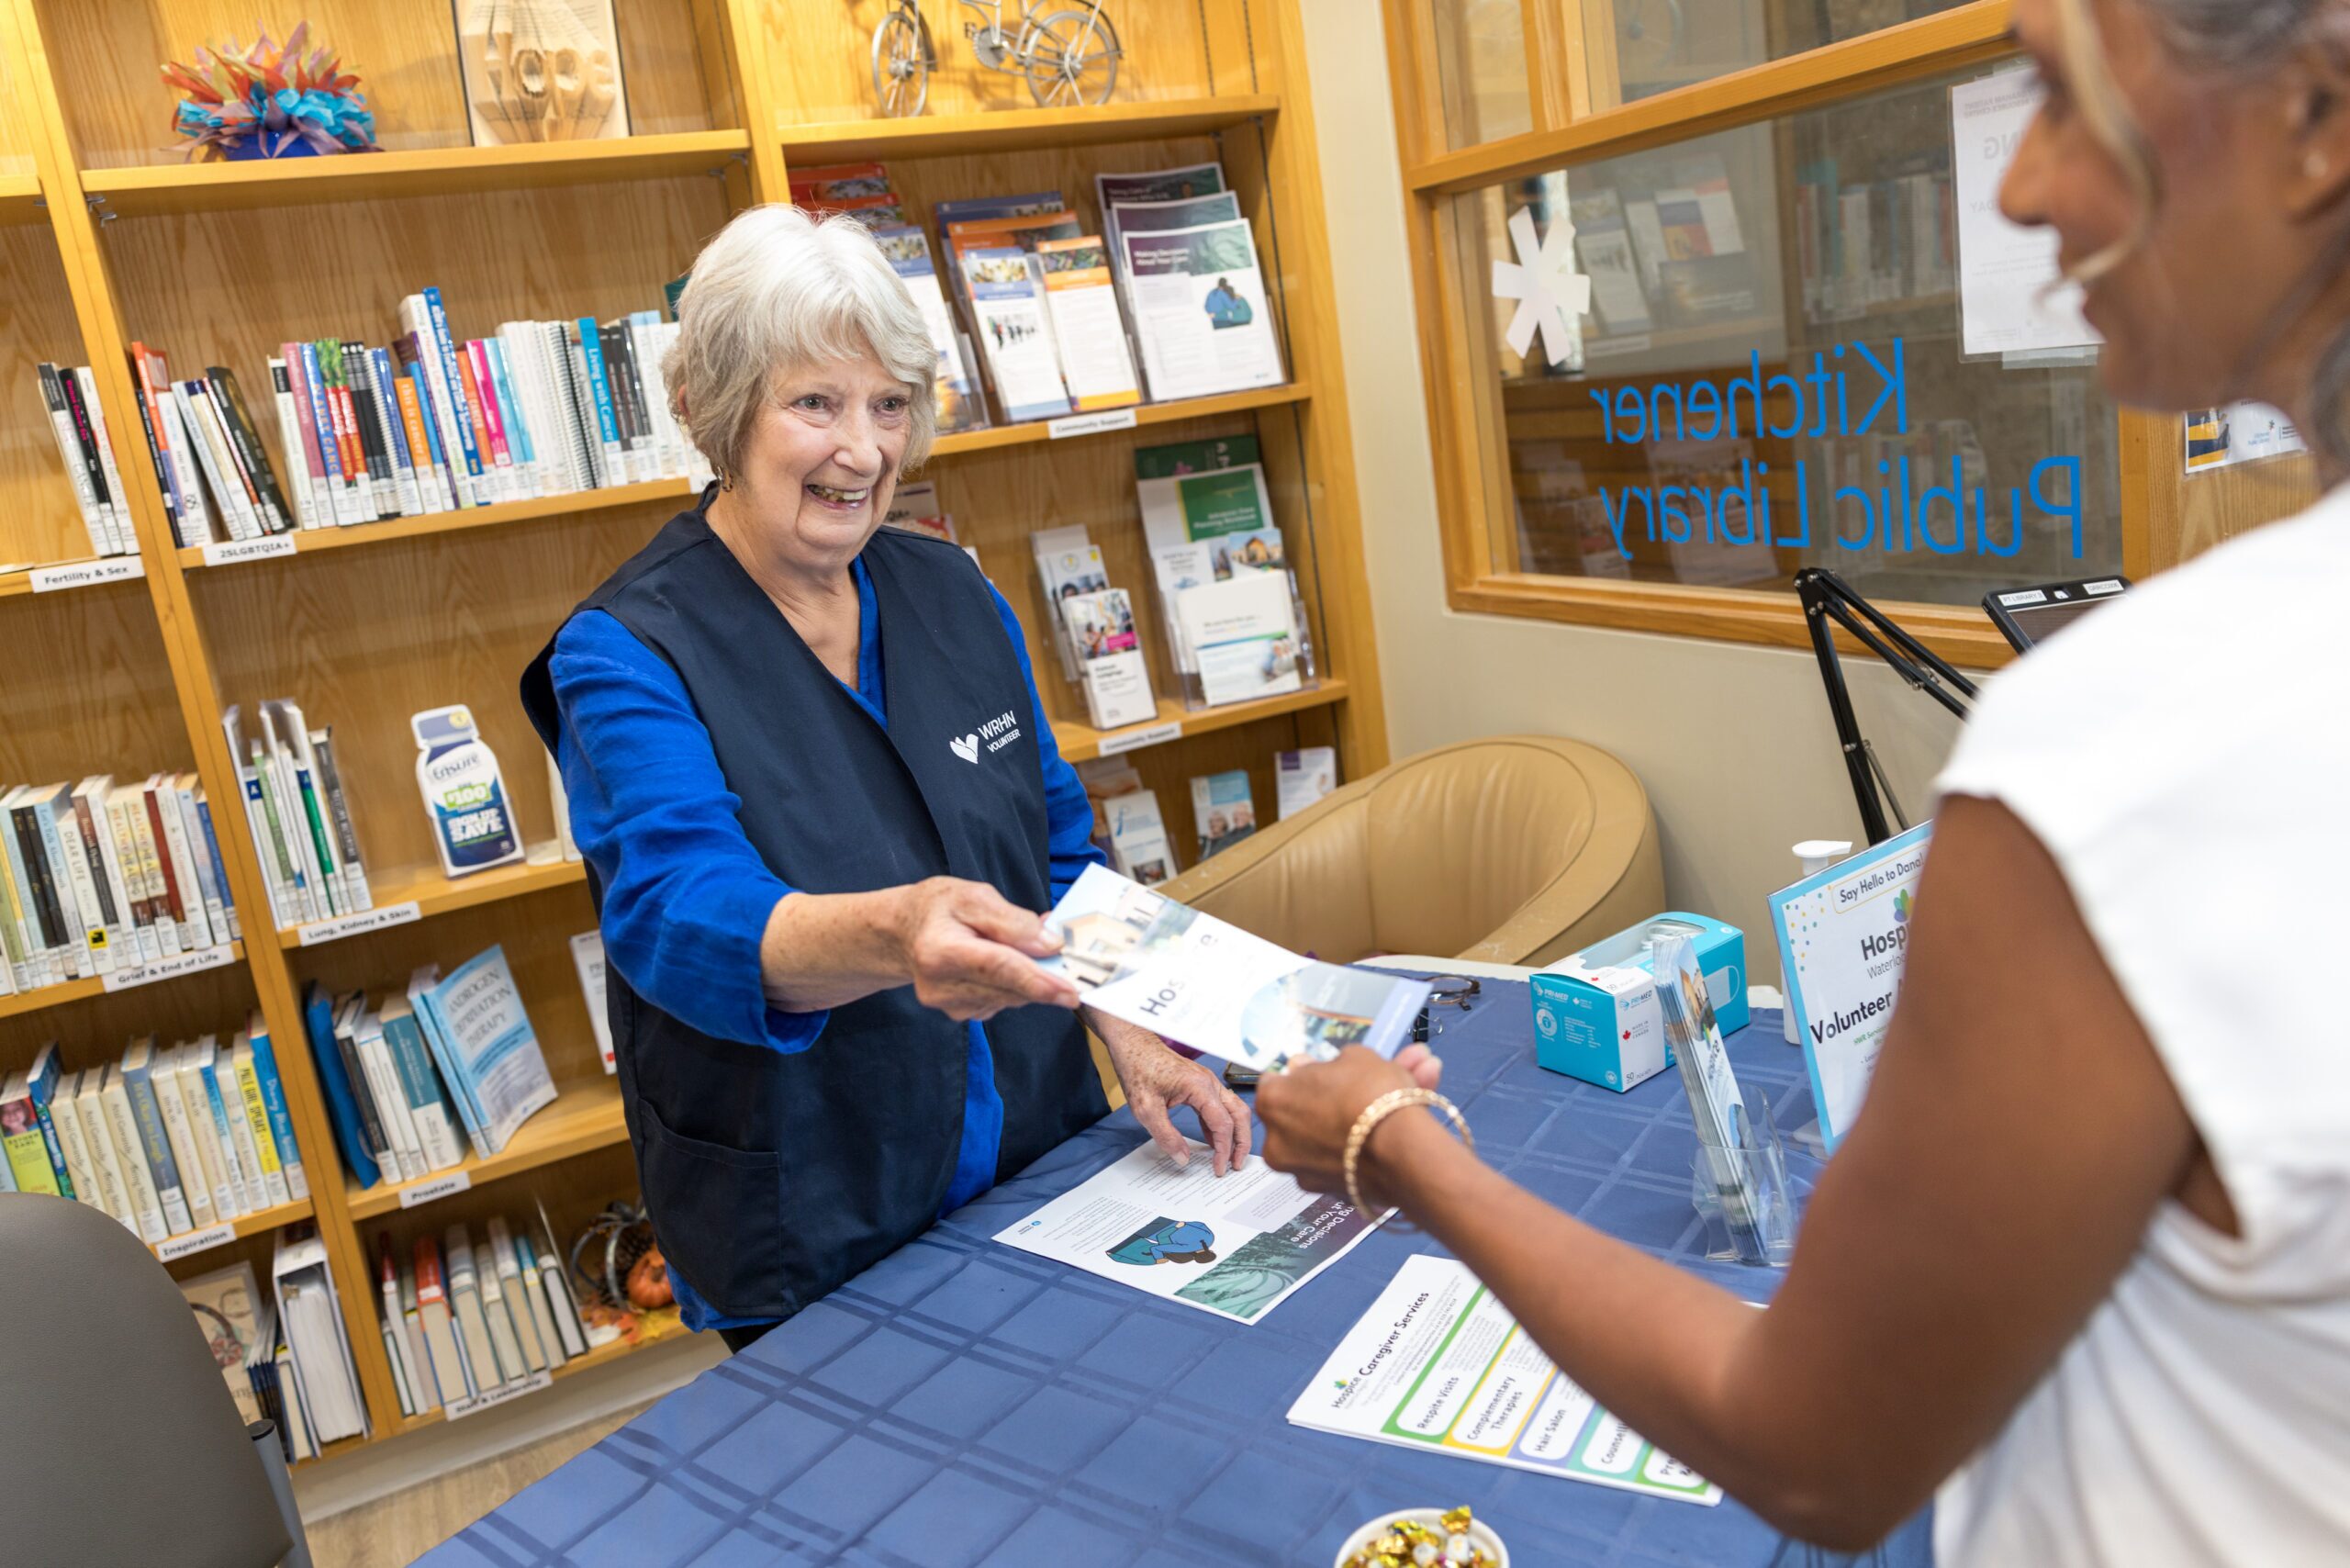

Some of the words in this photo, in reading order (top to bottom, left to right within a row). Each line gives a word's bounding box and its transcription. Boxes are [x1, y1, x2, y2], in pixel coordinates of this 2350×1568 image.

[587, 347, 601, 381] Living
[399, 382, 415, 408] this
[594, 382, 609, 401] with
[405, 407, 417, 418] is
[599, 402, 615, 442] Cancer
[1057, 420, 1099, 433] Community
[1100, 414, 1130, 429] Support
[408, 418, 425, 455] cancer
[219, 541, 291, 559] 2SLGBTQIA+
[45, 571, 91, 585] Fertility
[107, 566, 129, 575] Sex
[978, 710, 1016, 741] WRHN
[1104, 734, 1147, 751] Community
[1147, 727, 1177, 741] Support
[987, 729, 1021, 753] VOLUNTEER
[432, 752, 479, 780] Ensure
[62, 829, 81, 859] DEAR
[129, 801, 150, 846] HEALTHY
[140, 846, 161, 891] HEALING
[451, 821, 505, 844] SAVE
[110, 806, 131, 852] HEALTHY
[121, 851, 141, 896] HEALING
[70, 858, 87, 882] LIFE
[1840, 886, 1860, 903] Say
[1859, 874, 1885, 894] Hello
[1886, 868, 1897, 881] to
[1897, 852, 1925, 876] Dana!
[308, 927, 338, 941] Lung,
[341, 918, 375, 932] Kidney
[378, 913, 386, 922] &
[388, 908, 411, 920] Skin
[118, 968, 145, 984] Grief
[149, 967, 158, 976] &
[161, 960, 181, 973] End
[185, 958, 196, 969] of
[198, 952, 219, 966] Life
[449, 967, 501, 1014] ANDROGEN
[1630, 990, 1652, 1004] PRI-MED
[452, 984, 512, 1034] DEPRIVATION
[1809, 991, 1893, 1044] Volunteer
[465, 1012, 507, 1050] THERAPY
[131, 1081, 148, 1099] It's
[243, 1086, 260, 1105] GIRL
[61, 1113, 76, 1134] Atul
[84, 1107, 98, 1128] Atul
[109, 1101, 124, 1121] Atul
[136, 1096, 154, 1123] Okay
[115, 1119, 134, 1155] Gawande
[142, 1121, 158, 1135] to
[66, 1132, 85, 1168] Gawande
[88, 1126, 107, 1162] Gawande
[146, 1133, 166, 1164] Laugh
[410, 1182, 456, 1200] Prostate
[1298, 1216, 1345, 1249] Decisions
[1314, 1210, 1337, 1226] Your
[162, 1230, 229, 1258] Inspiration
[1291, 1226, 1315, 1242] Care
[1331, 1377, 1361, 1408] Hospice
[1359, 1330, 1401, 1376] Caregiver
[1394, 1292, 1429, 1328] Services
[490, 1378, 543, 1402] Leadership
[1417, 1394, 1442, 1429] Respite
[1438, 1377, 1460, 1399] Visits
[1468, 1376, 1516, 1441] Complementary
[1491, 1391, 1523, 1431] Therapies
[1534, 1432, 1552, 1453] Hair
[1547, 1408, 1567, 1434] Salon
